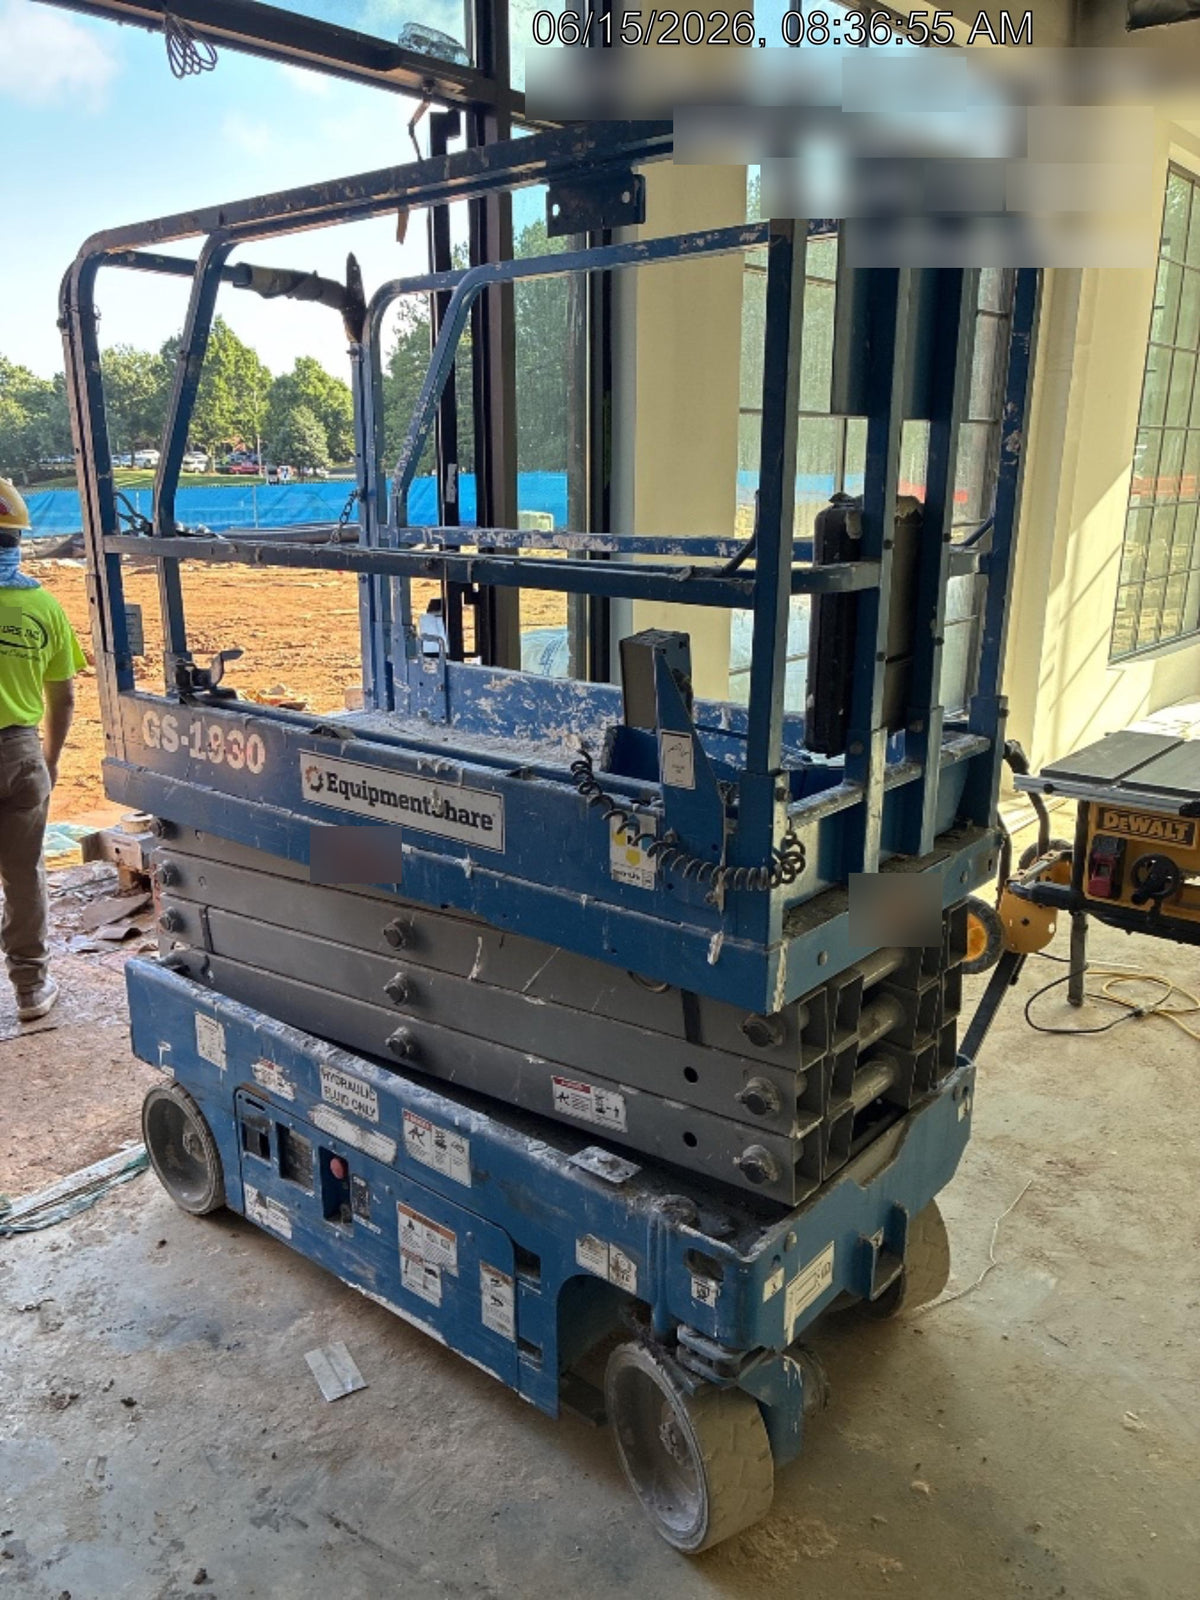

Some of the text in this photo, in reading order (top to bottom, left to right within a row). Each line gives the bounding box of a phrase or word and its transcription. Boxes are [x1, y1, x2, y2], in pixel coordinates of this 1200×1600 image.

[142, 710, 266, 775] GS-1930
[322, 1069, 376, 1102] HYDRAULIC
[351, 1098, 376, 1117] ONLY
